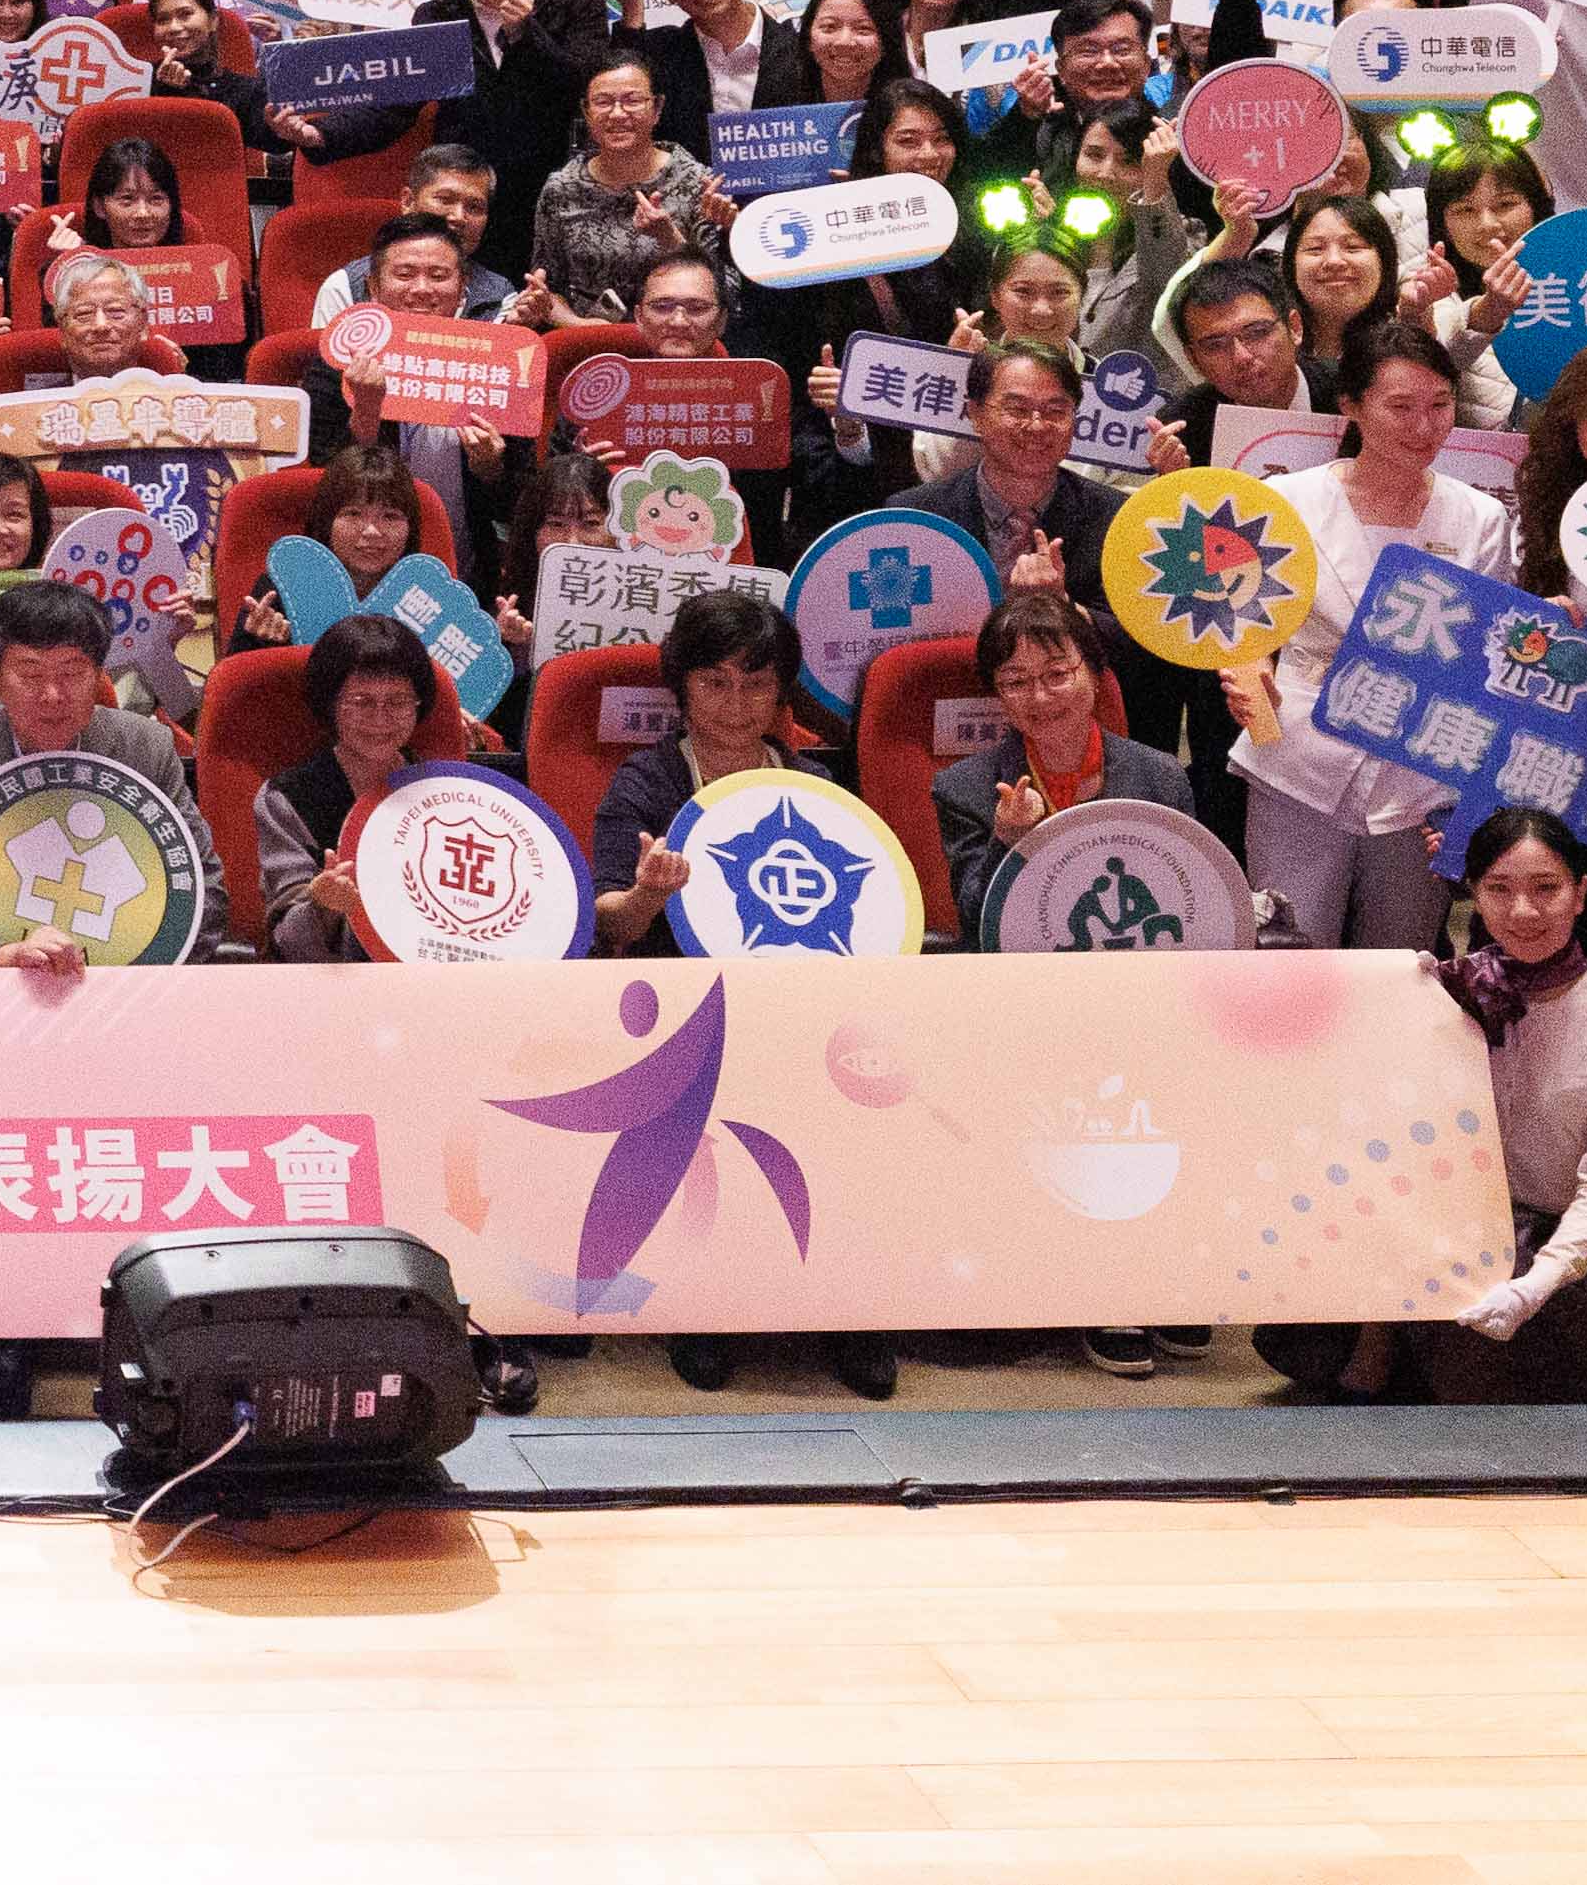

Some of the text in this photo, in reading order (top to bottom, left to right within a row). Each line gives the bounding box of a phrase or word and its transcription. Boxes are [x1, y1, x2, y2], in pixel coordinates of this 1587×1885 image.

[1420, 36, 1516, 59] 中華電信
[315, 55, 426, 86] JABIL
[1472, 61, 1516, 75] Telecom
[1208, 98, 1312, 129] MERRY
[718, 121, 818, 143] HEALTH &
[719, 139, 828, 162] WELLBEING
[825, 195, 927, 230] 中華電信
[885, 219, 930, 237] Telecom
[625, 403, 754, 423] 鴻海精密工業
[394, 792, 544, 879] TAIPEI MEDICAL UNIVERSITY
